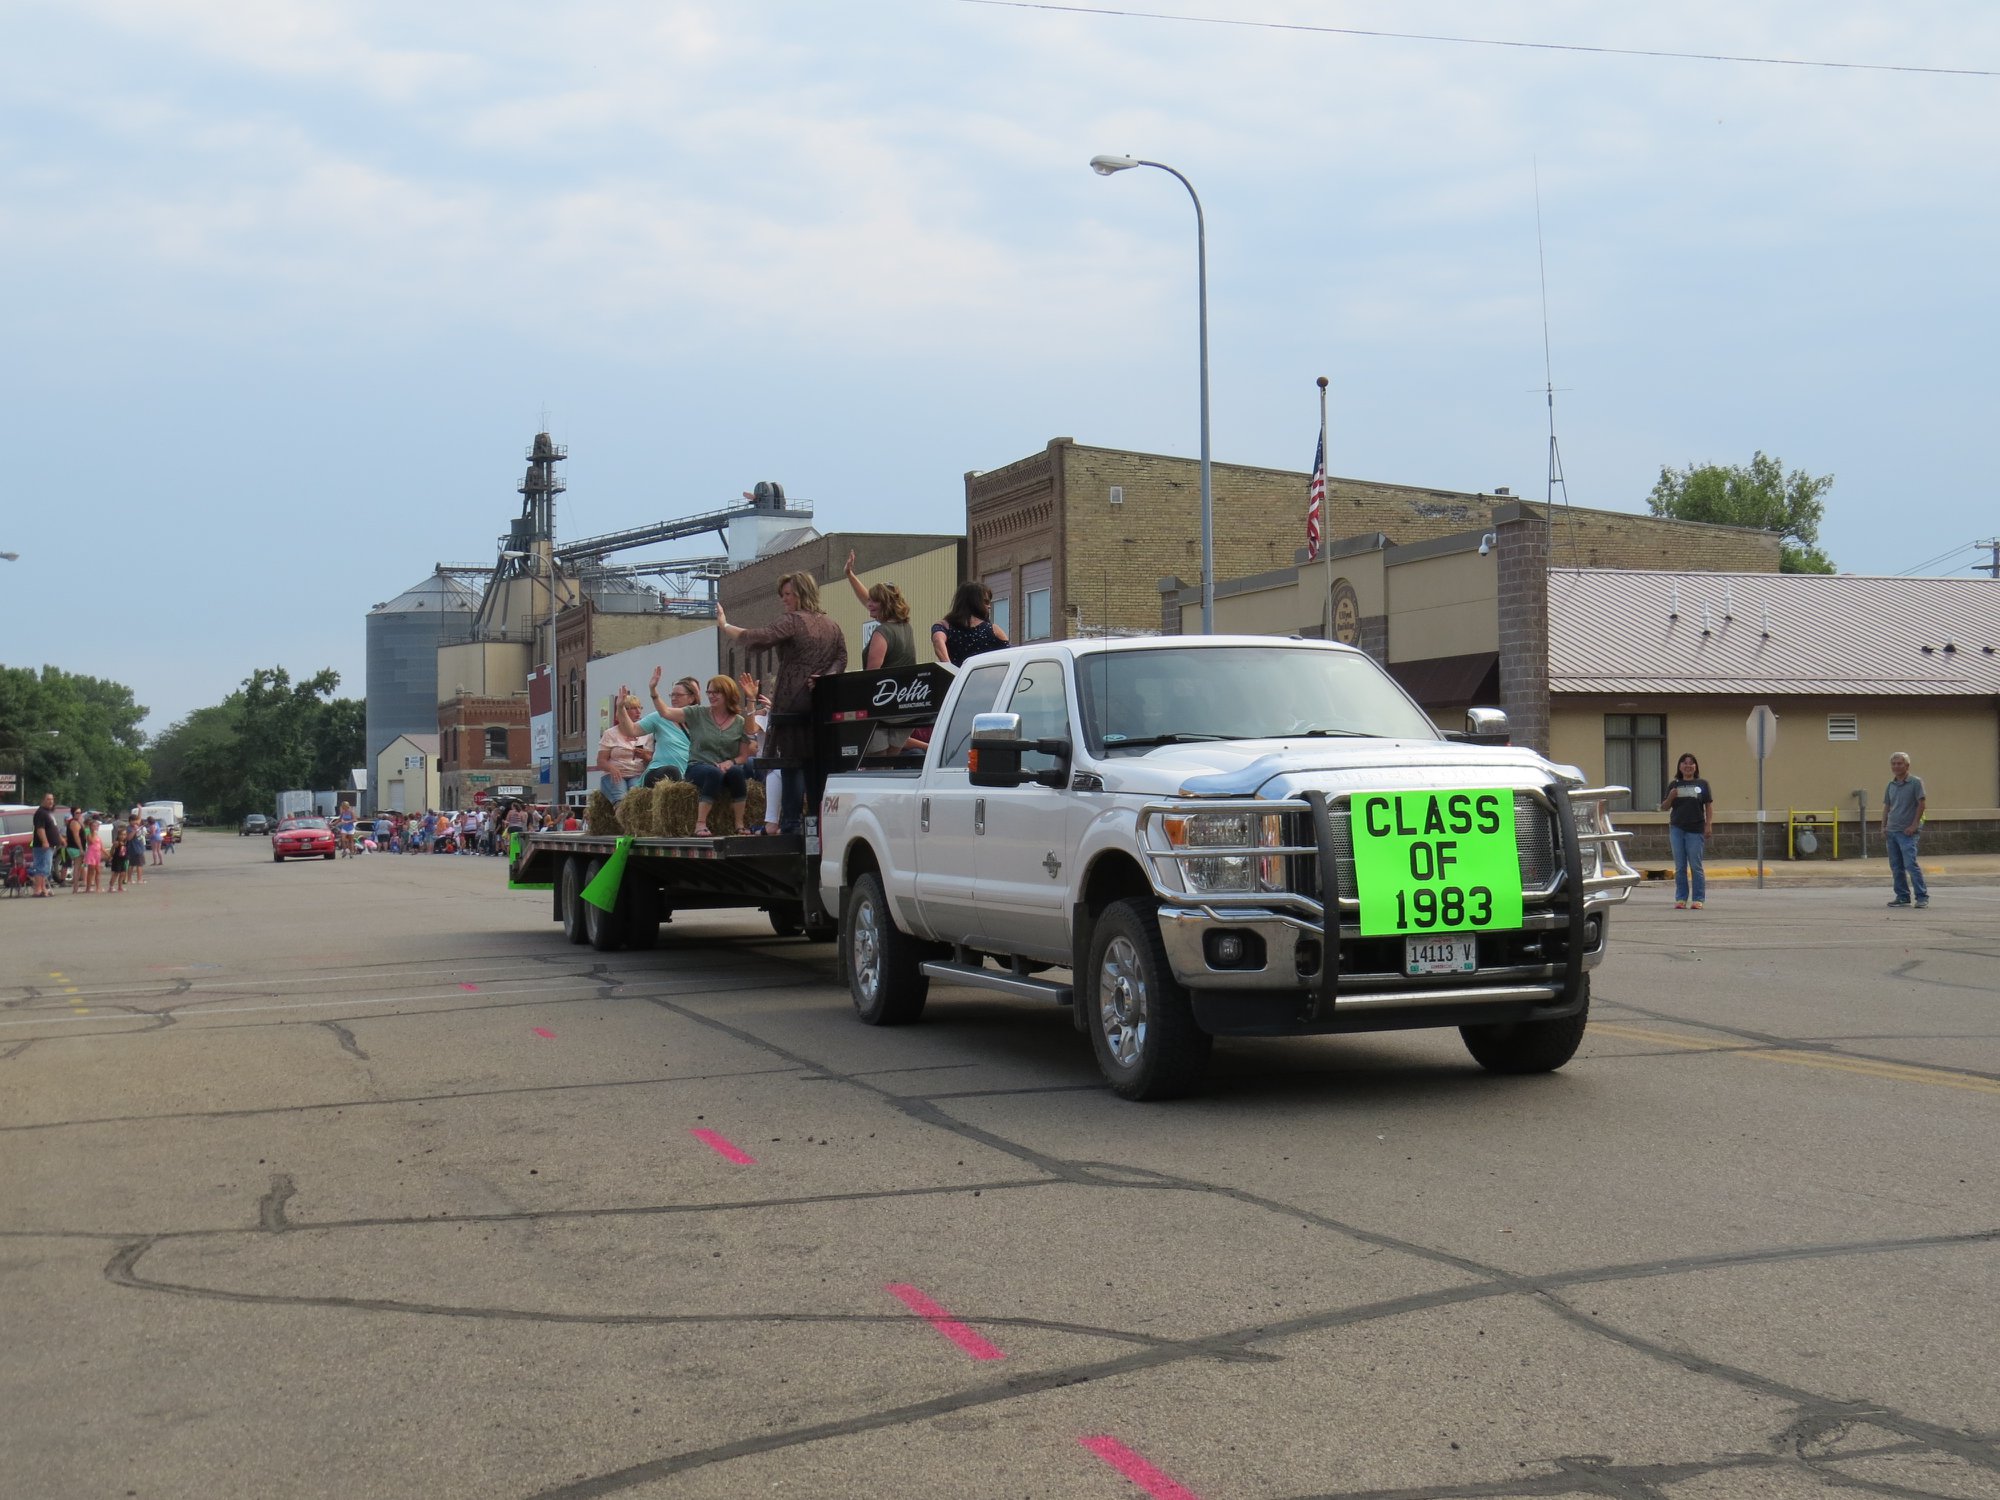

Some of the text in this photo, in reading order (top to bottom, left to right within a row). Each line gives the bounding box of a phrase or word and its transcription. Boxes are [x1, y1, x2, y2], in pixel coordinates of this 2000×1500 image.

[872, 678, 931, 706] Delta
[824, 795, 840, 813] FX4
[1365, 794, 1500, 837] CLASS
[1409, 841, 1457, 881] OF
[1395, 886, 1492, 929] 1983
[1411, 943, 1471, 963] 14113 V
